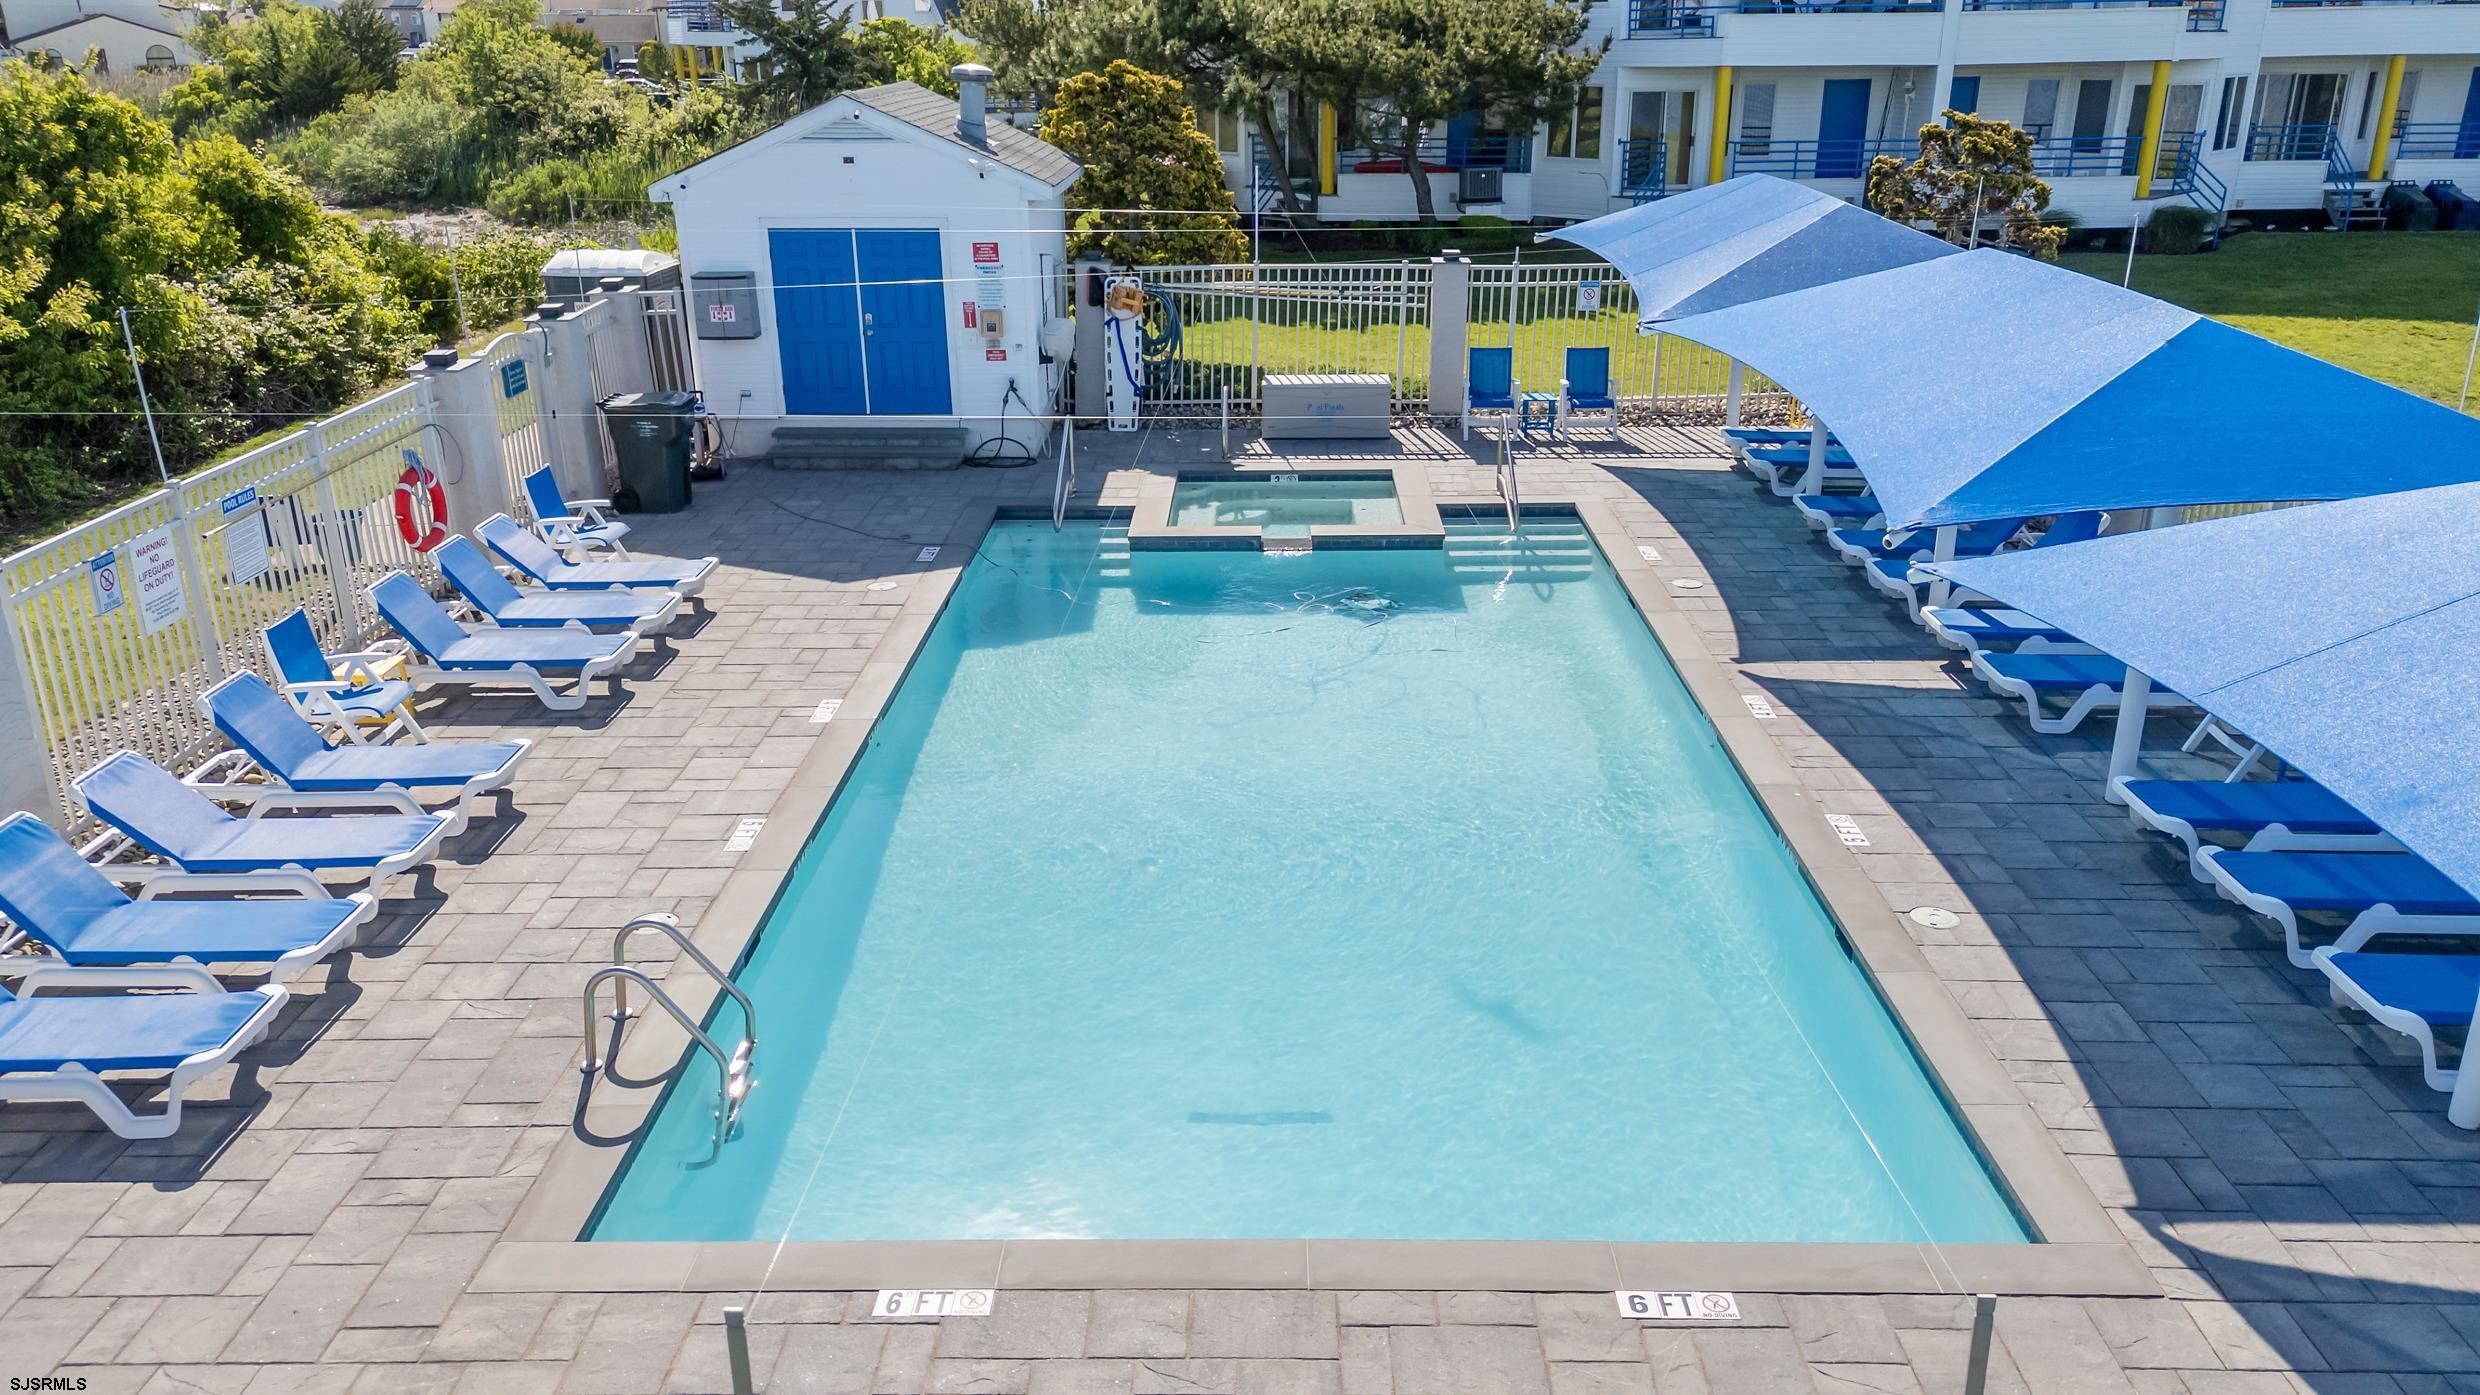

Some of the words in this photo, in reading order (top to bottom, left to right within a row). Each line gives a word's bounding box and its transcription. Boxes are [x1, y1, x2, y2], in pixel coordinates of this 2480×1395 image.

[223, 499, 238, 511] POOL
[238, 489, 254, 505] RULES
[135, 536, 168, 558] WARNING!
[138, 558, 175, 582] LIFEGUARD
[149, 553, 160, 565] NO
[144, 582, 154, 592] ON
[1834, 824, 1861, 835] FT
[886, 1292, 903, 1314] 6
[914, 1291, 954, 1314] FT
[1628, 1294, 1649, 1314] 6
[1657, 1293, 1692, 1317] FT
